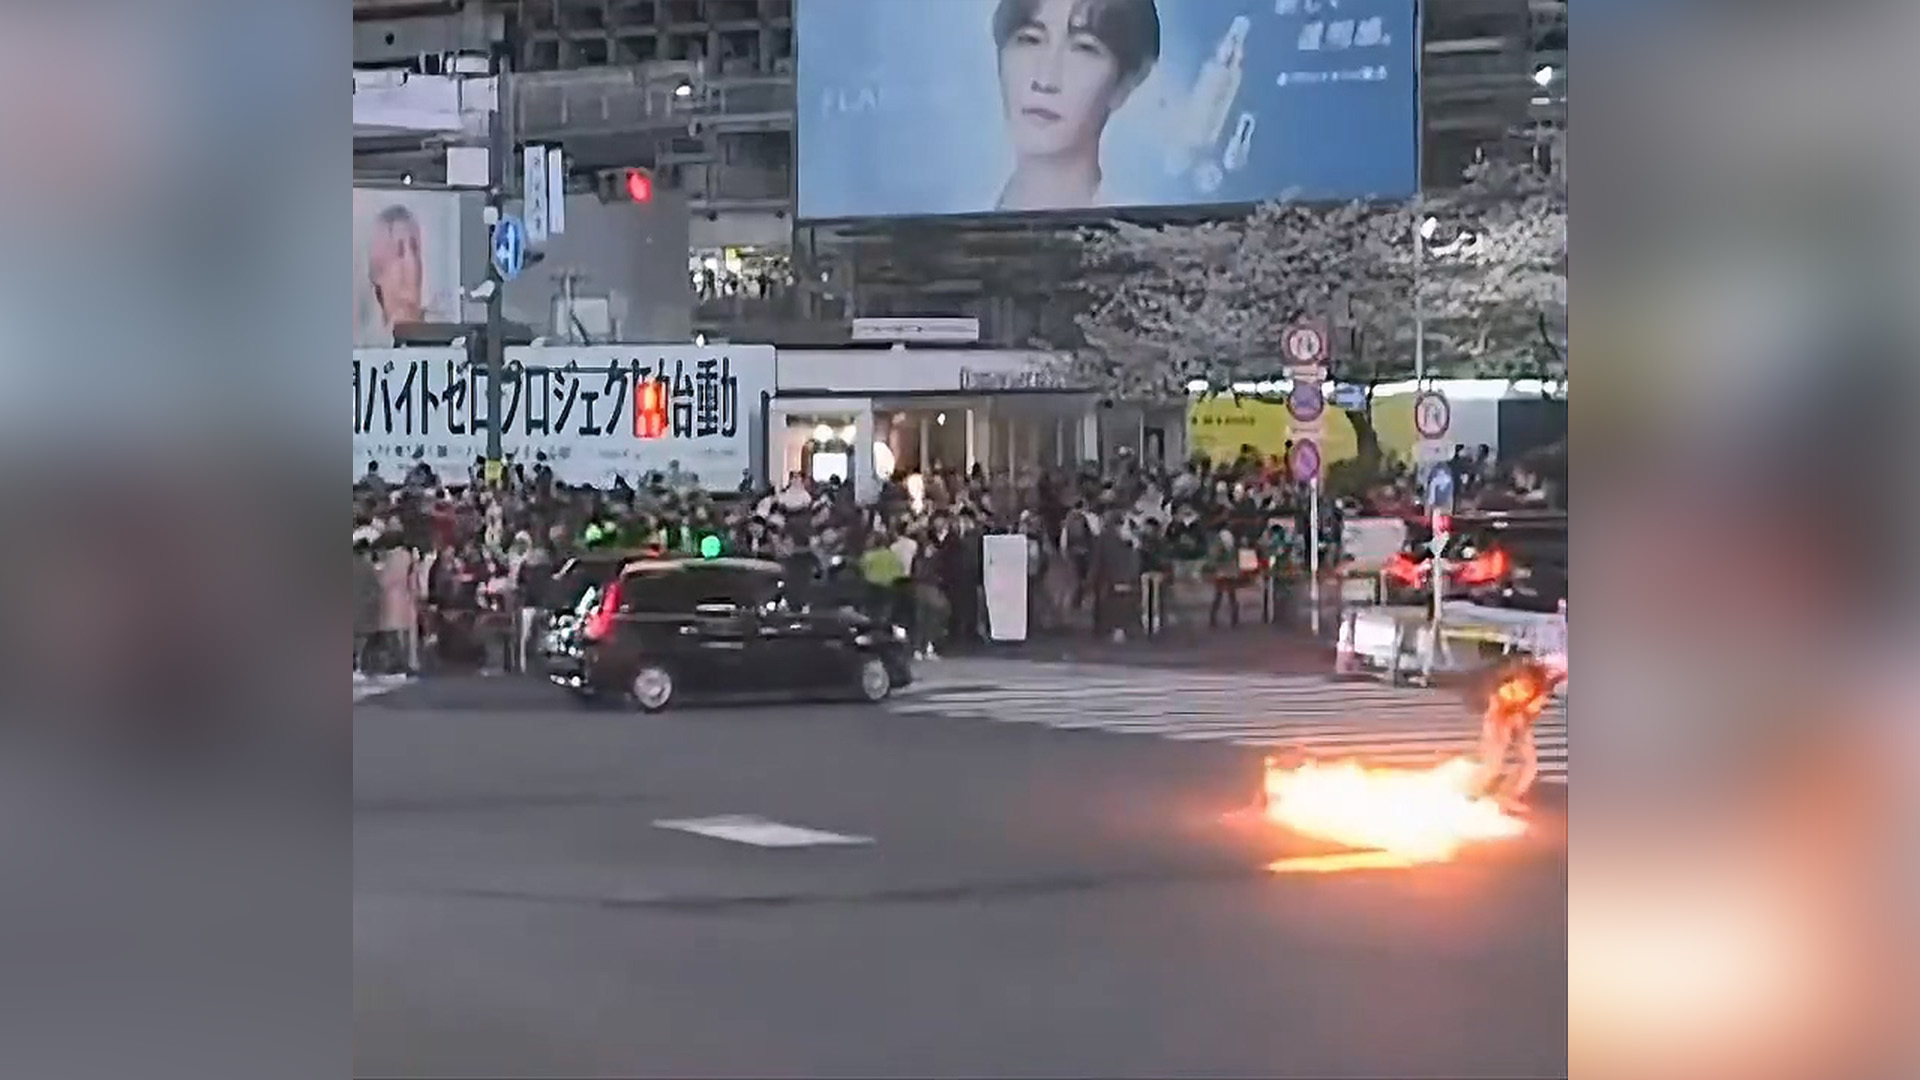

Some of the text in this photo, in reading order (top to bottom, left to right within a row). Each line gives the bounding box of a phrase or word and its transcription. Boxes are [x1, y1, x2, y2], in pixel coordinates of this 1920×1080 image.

[353, 357, 737, 438] バイトゼロプロジェク始動
